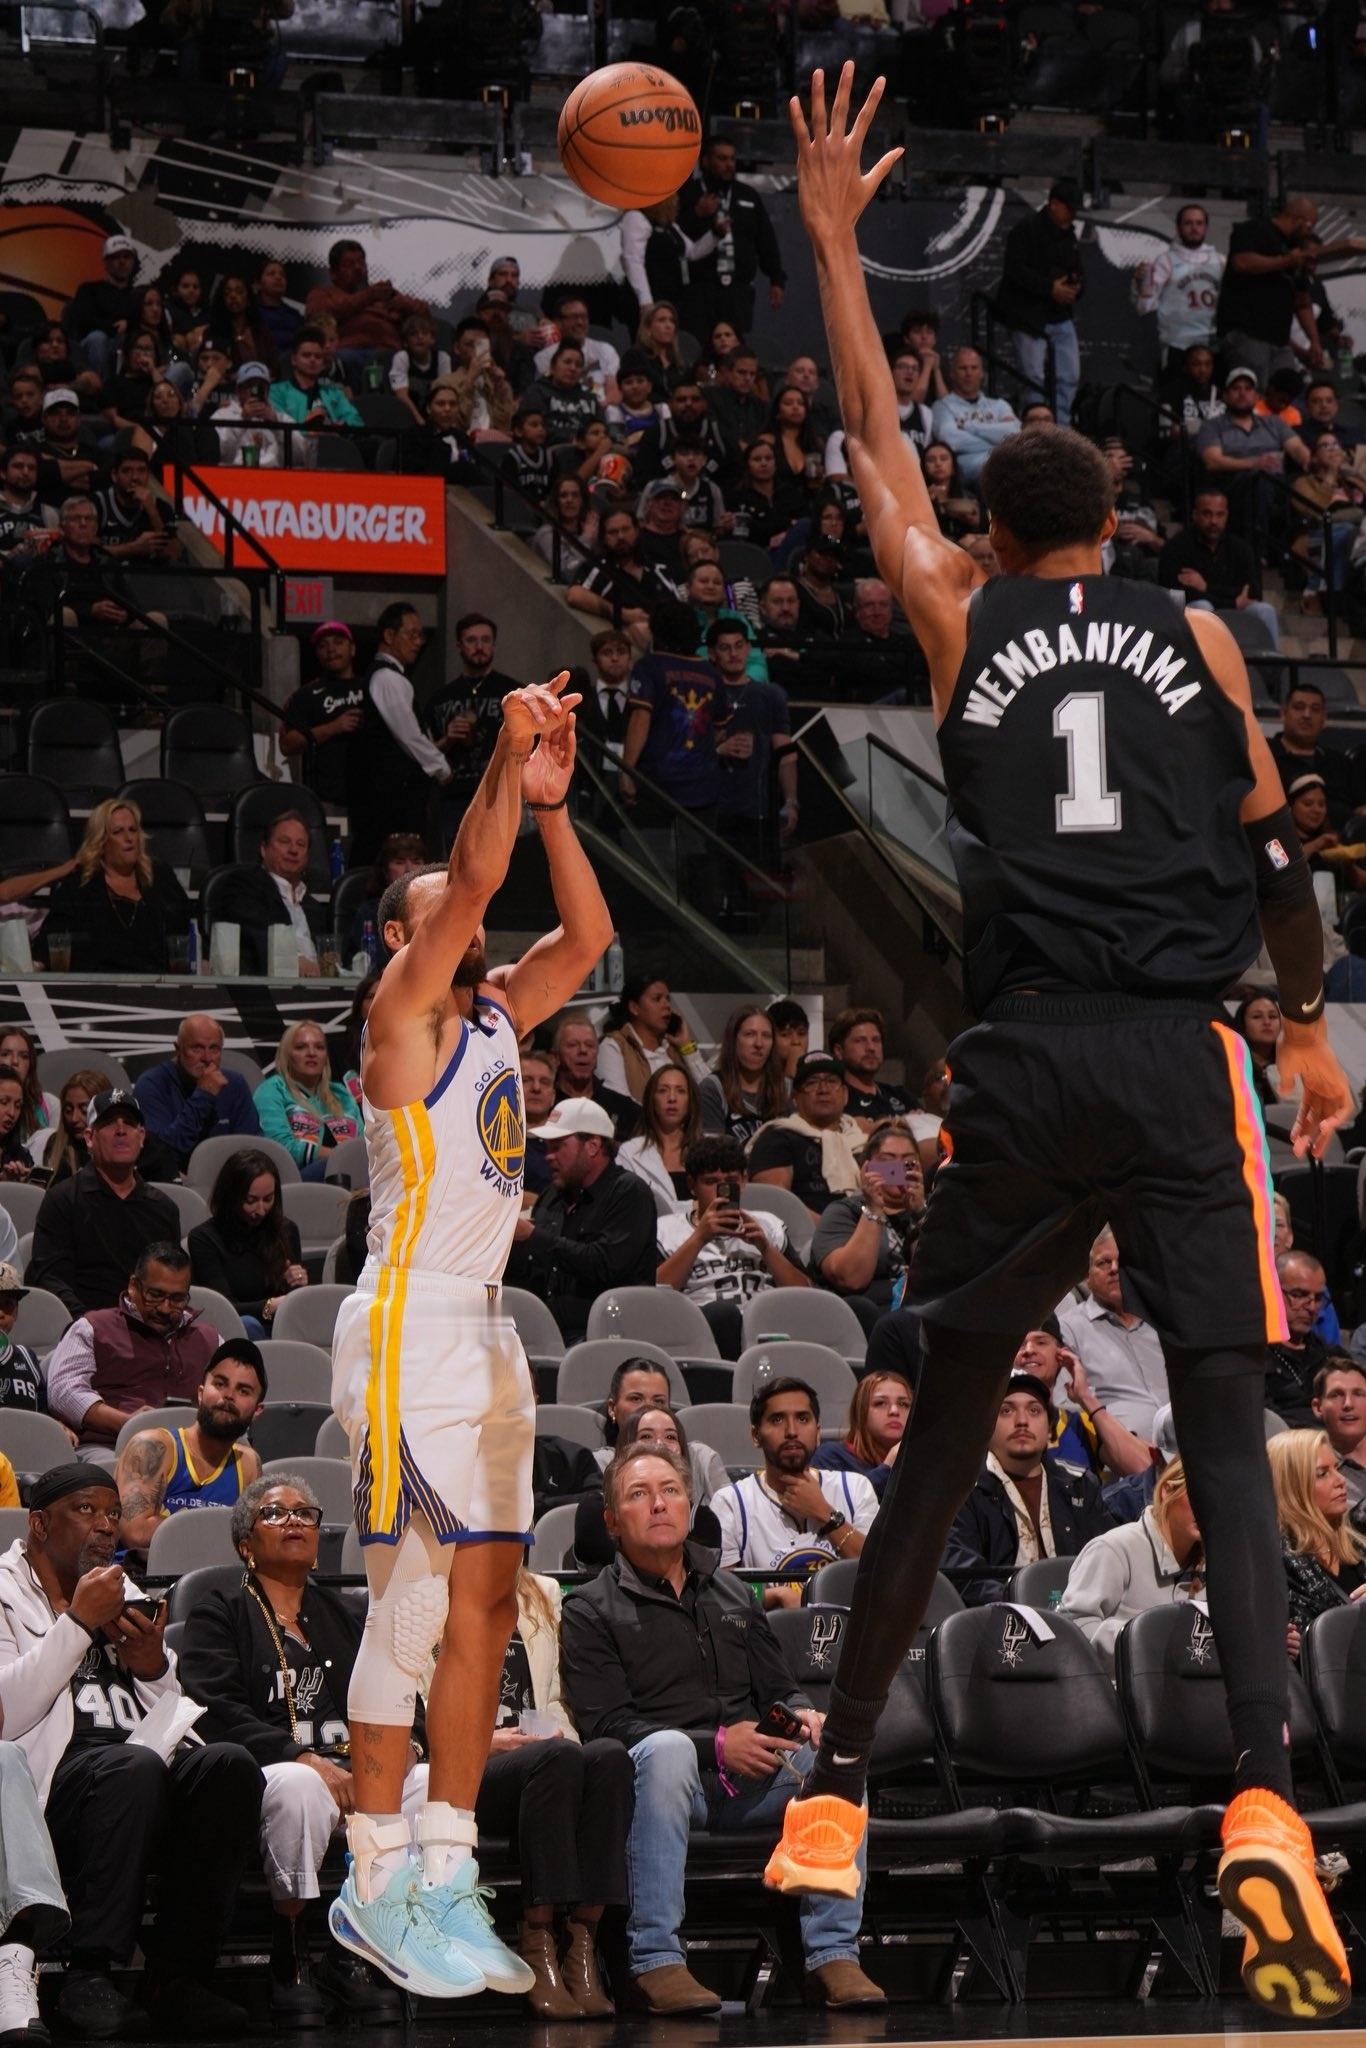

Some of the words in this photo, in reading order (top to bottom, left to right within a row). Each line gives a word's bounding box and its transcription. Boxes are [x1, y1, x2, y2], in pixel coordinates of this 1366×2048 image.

[620, 106, 699, 133] Wilson
[183, 496, 428, 545] WHATABURGER
[285, 583, 324, 616] EXIT
[961, 621, 1202, 729] WEMBANYAMA
[1052, 690, 1123, 834] 1
[75, 1684, 142, 1732] 40
